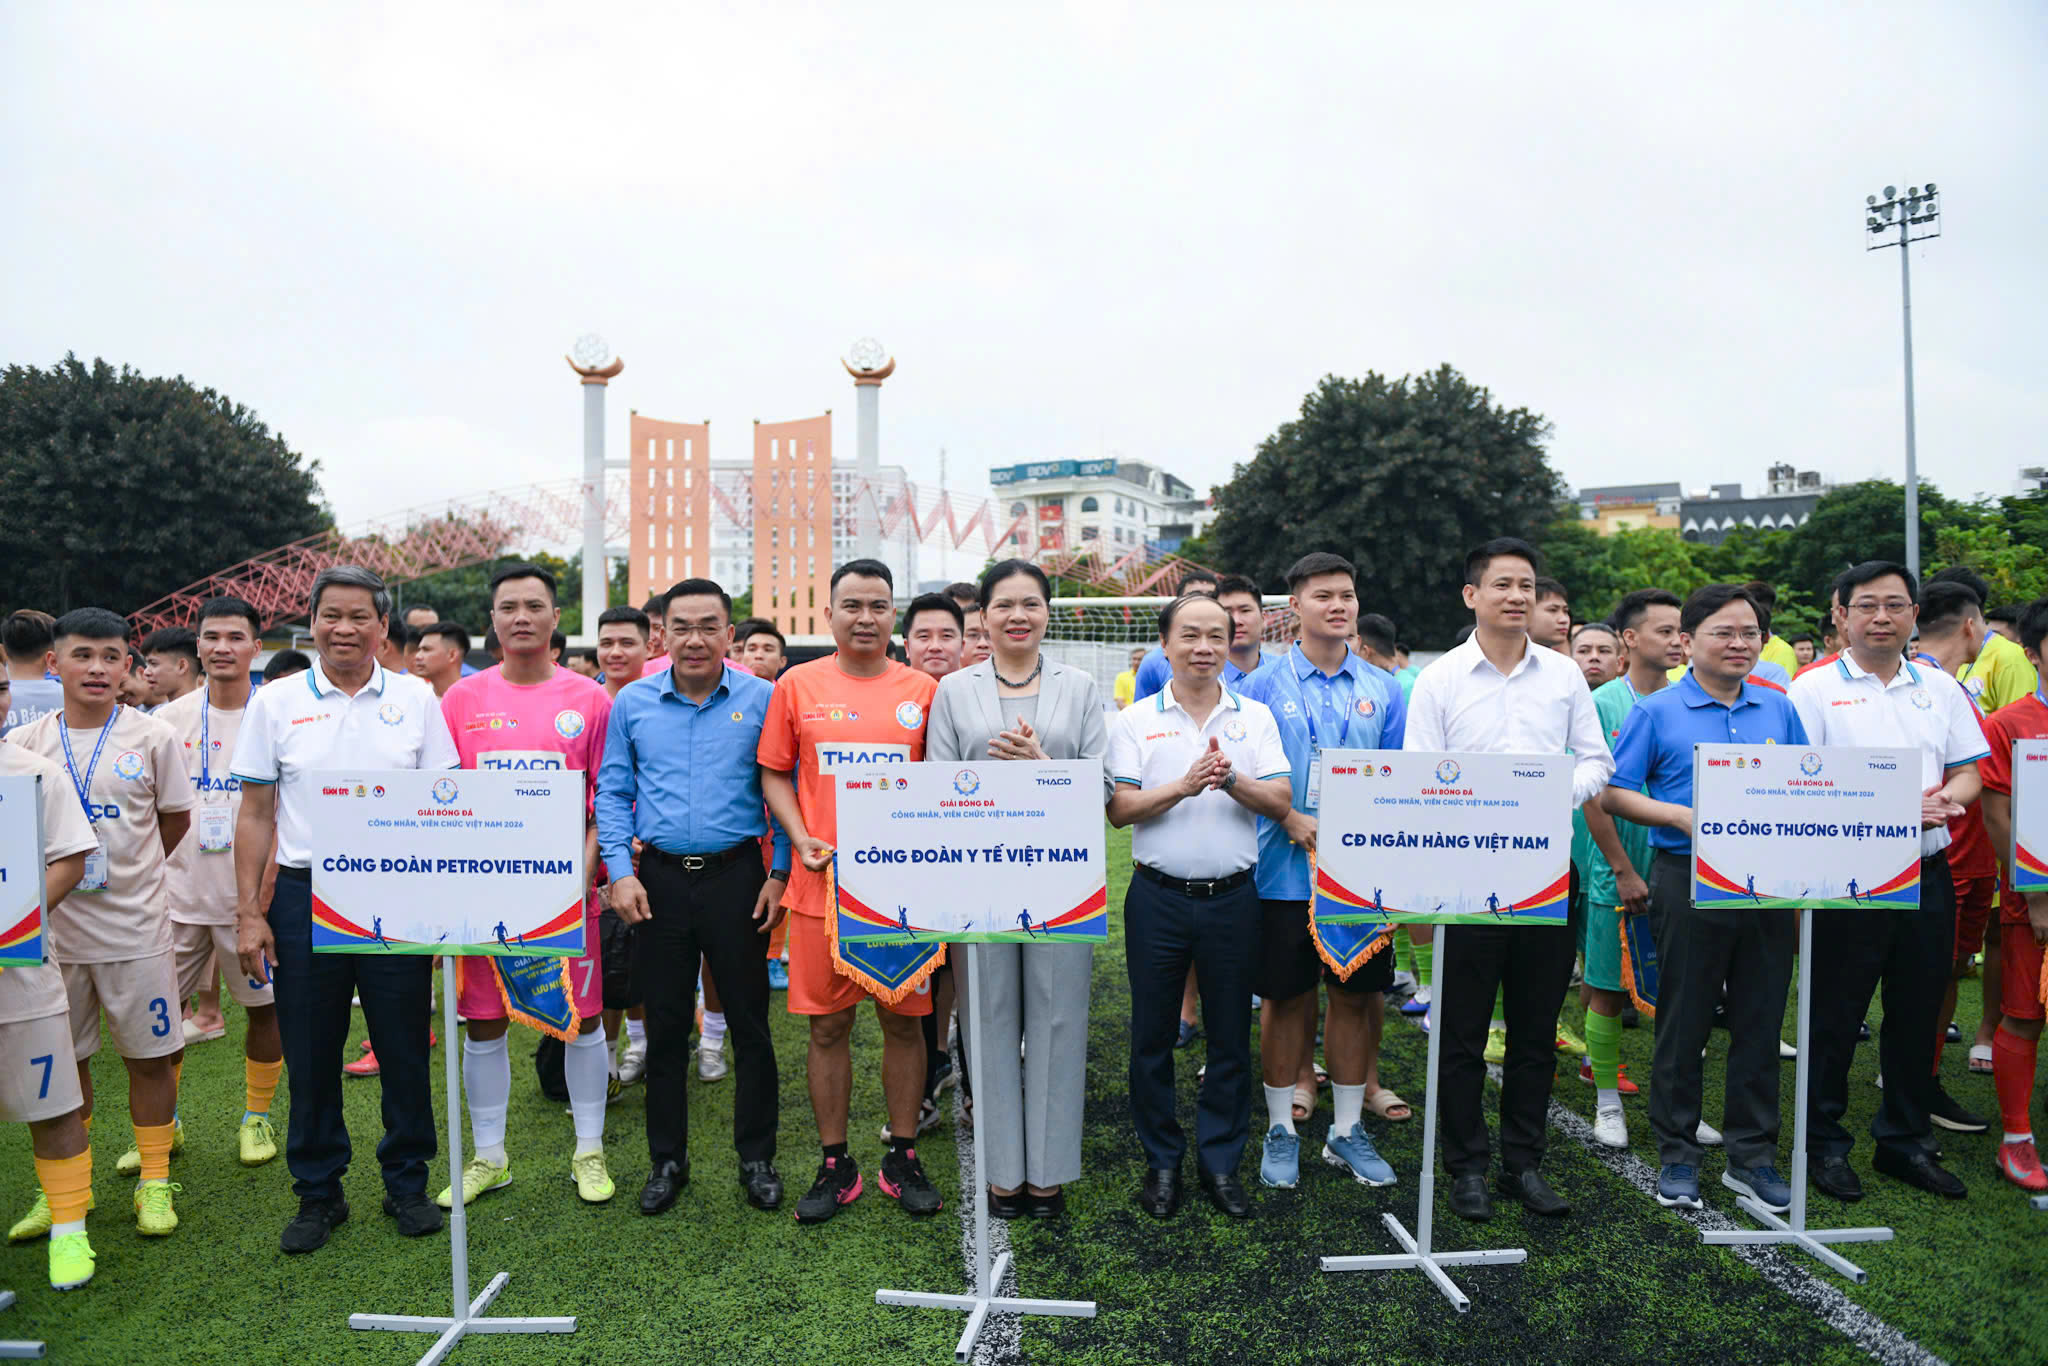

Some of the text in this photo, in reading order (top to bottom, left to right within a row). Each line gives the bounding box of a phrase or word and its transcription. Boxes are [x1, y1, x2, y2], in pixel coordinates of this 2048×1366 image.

[1422, 787, 1437, 795] GIẢI
[1439, 787, 1460, 795] BÓNG
[1768, 788, 1788, 796] NHÂN,
[1827, 789, 1841, 798] VIỆT
[940, 799, 995, 807] GIẢI BÓNG ĐÁ
[1399, 797, 1421, 806] NHÂN,
[1443, 798, 1463, 806] CHỨC
[1465, 798, 1481, 807] VIỆT
[418, 808, 434, 816] GIẢI
[462, 808, 473, 816] ĐÁ
[891, 810, 915, 818] CÔNG
[917, 810, 941, 819] NHÂN,
[944, 810, 961, 818] VIÊN
[963, 809, 985, 818] CHỨC
[988, 809, 1004, 819] VIỆT
[368, 819, 392, 827] CÔNG
[394, 819, 418, 828] NHÂN,
[421, 819, 438, 828] VIÊN
[441, 820, 463, 828] CHỨC
[466, 820, 482, 829] VIỆT
[1701, 820, 1917, 841] CĐ CÔNG THƯƠNG VIỆT NAM 1
[1341, 831, 1549, 853] CĐ NGÂN HÀNG VIỆT NAM
[854, 843, 1088, 867] CÔNG ĐOÀN Y TẾ VIỆT NAM
[322, 854, 572, 874] CÔNG ĐOÀN PETROVIETNAM
[578, 960, 594, 997] 7
[149, 997, 170, 1037] 3
[30, 1054, 54, 1099] 7
